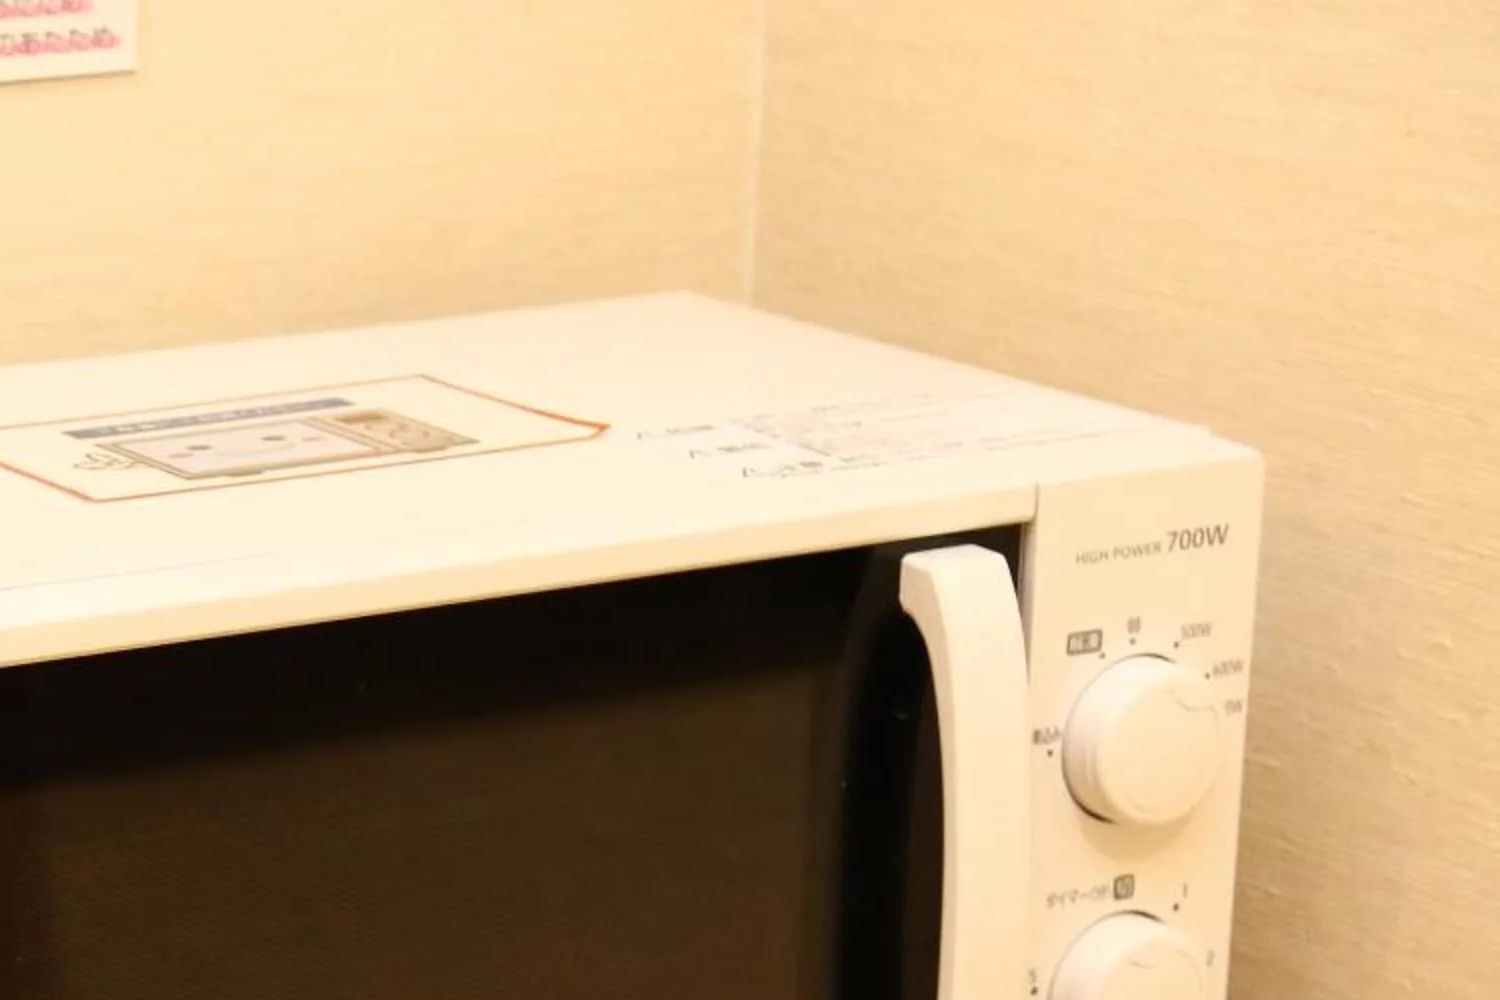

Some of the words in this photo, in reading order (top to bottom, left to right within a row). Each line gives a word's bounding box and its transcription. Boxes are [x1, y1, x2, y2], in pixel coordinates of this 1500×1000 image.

[1076, 550, 1109, 566] HIGH
[1113, 541, 1162, 560] POWER
[1167, 523, 1230, 553] 700W
